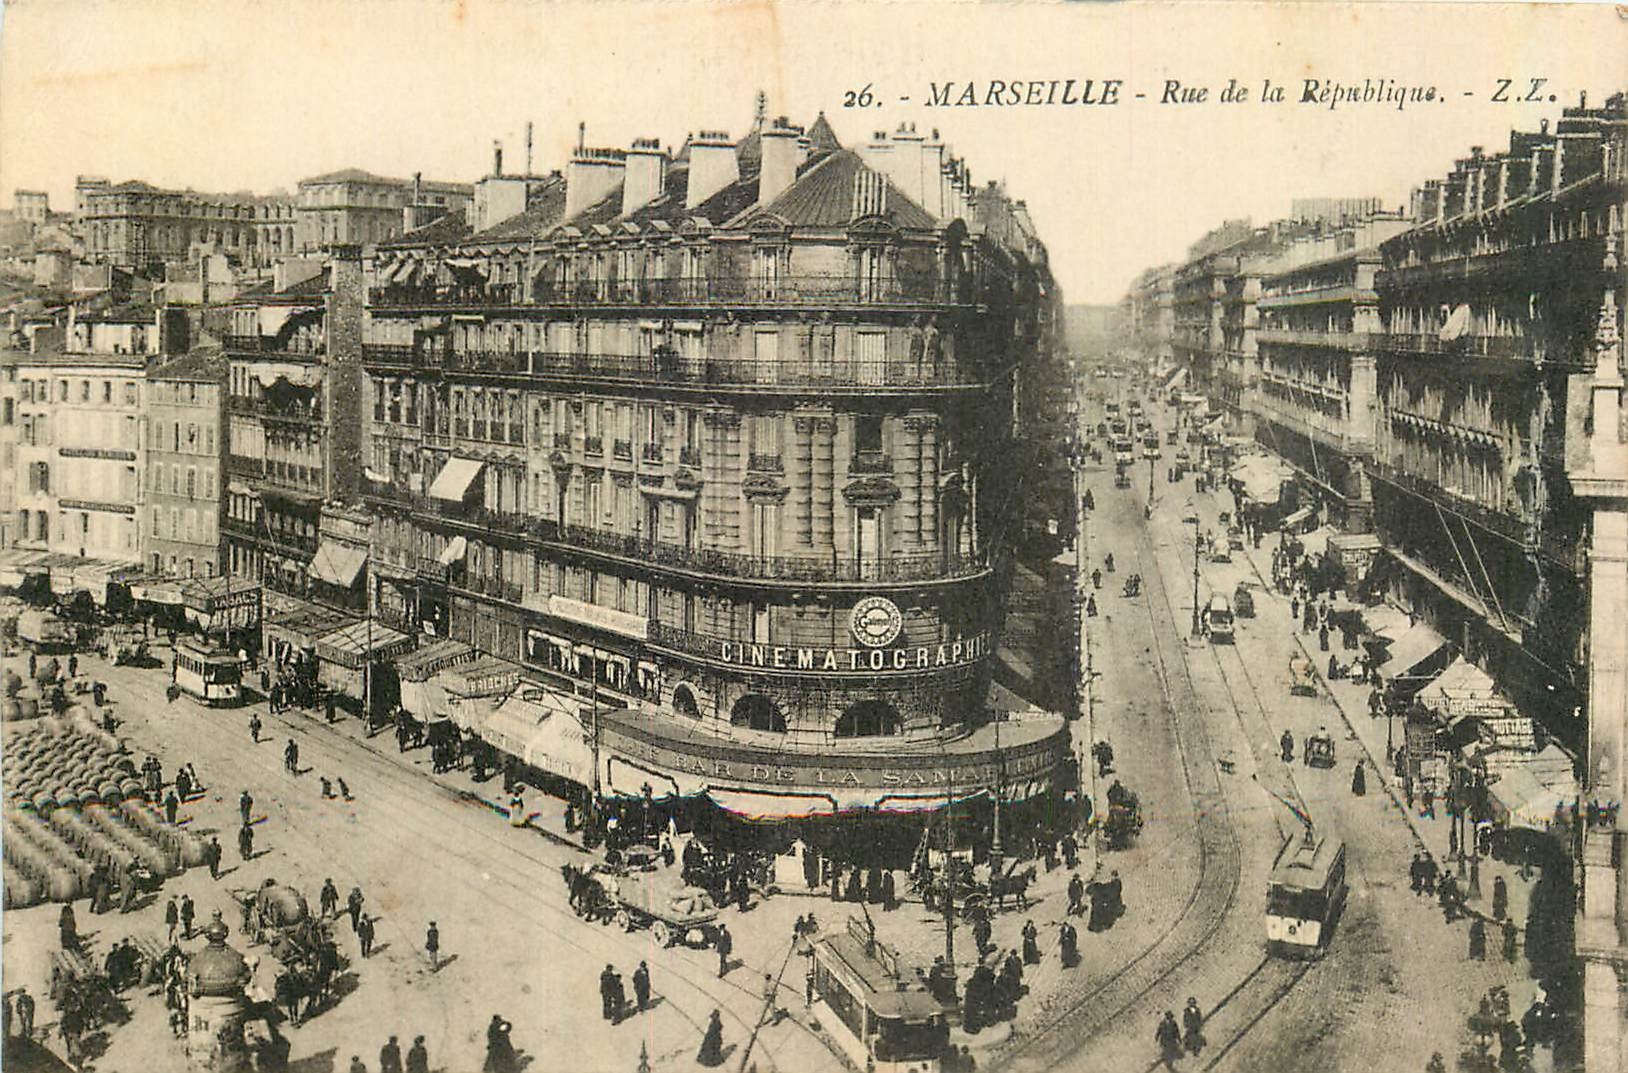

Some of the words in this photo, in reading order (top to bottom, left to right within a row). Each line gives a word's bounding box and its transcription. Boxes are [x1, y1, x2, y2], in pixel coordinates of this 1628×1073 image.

[674, 754, 733, 777] BAR
[751, 766, 795, 782] DE
[816, 769, 864, 785] LA
